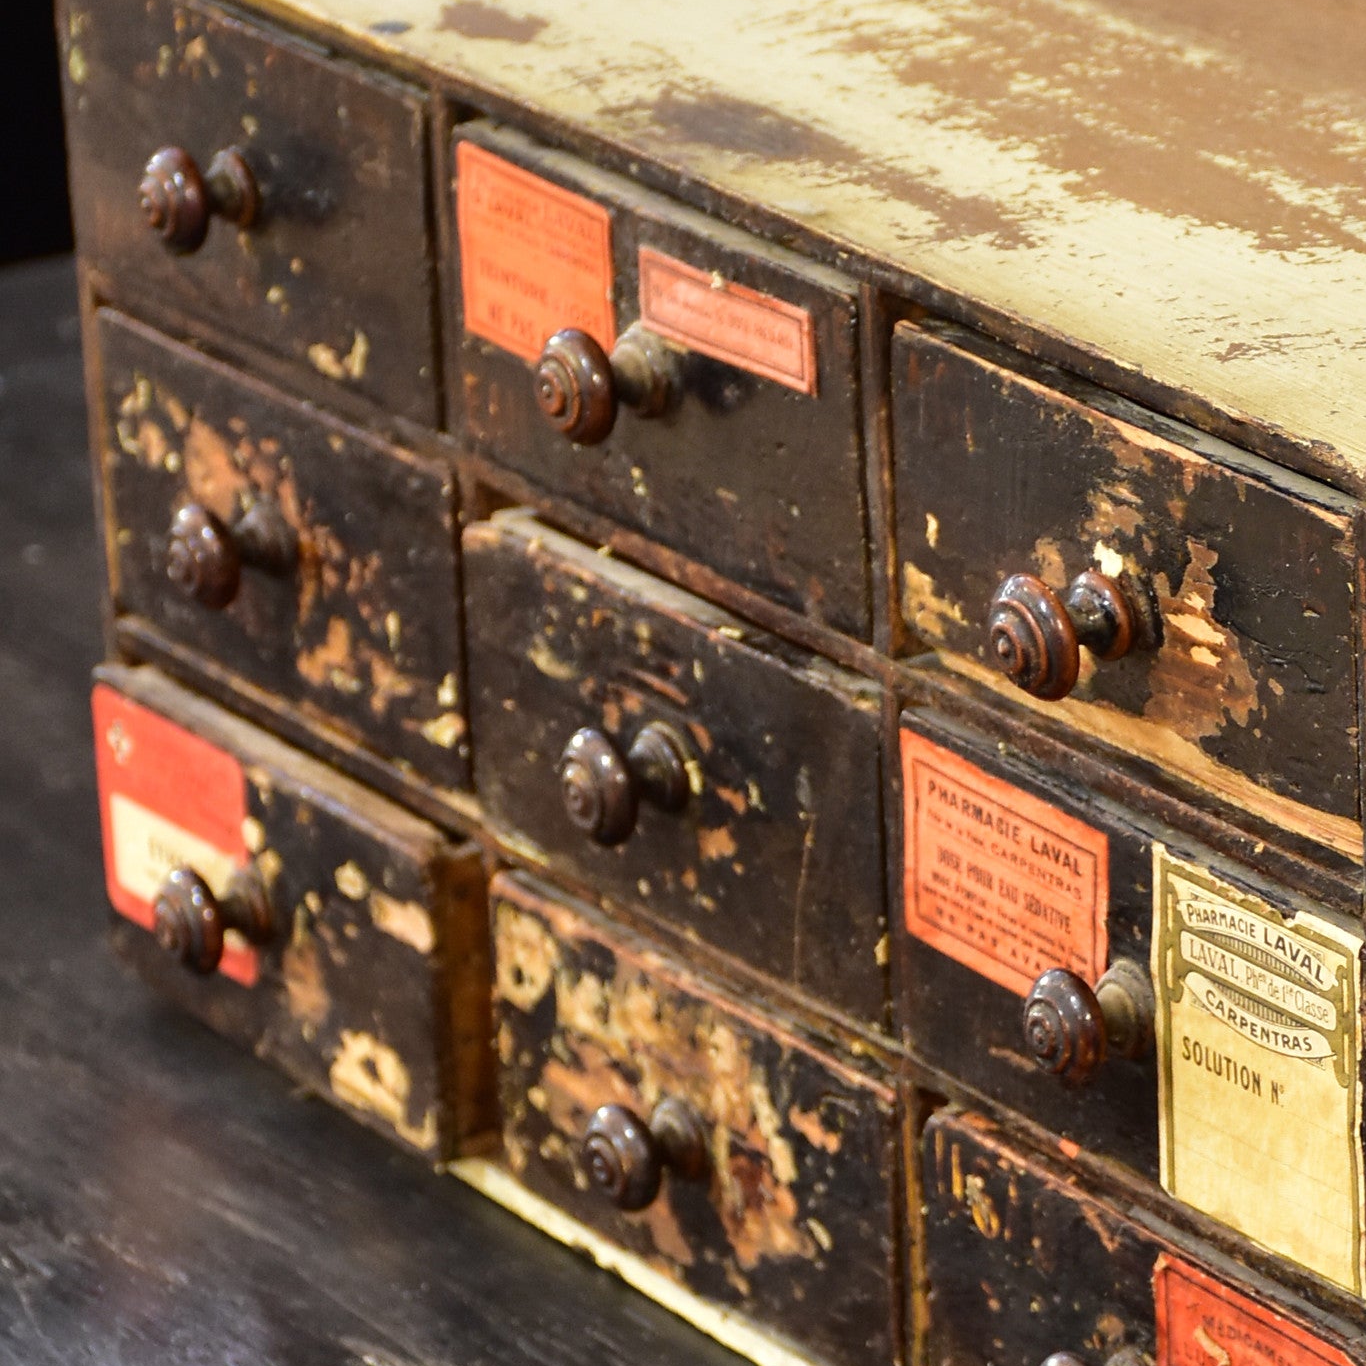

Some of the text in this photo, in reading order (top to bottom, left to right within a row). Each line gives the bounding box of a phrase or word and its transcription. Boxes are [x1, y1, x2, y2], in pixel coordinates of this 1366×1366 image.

[927, 779, 1021, 846] PHARMACIE
[1030, 835, 1083, 878] LAVAL
[990, 841, 1082, 901] CARPENTRAS
[998, 878, 1019, 905] EAU
[1186, 902, 1257, 939] PHARMACIE
[1263, 927, 1325, 985] LAVAL
[1205, 989, 1312, 1052] CARPENTRAS
[1268, 977, 1280, 998] de
[1294, 989, 1329, 1024] Classe
[1181, 1035, 1262, 1097] SOLUTION
